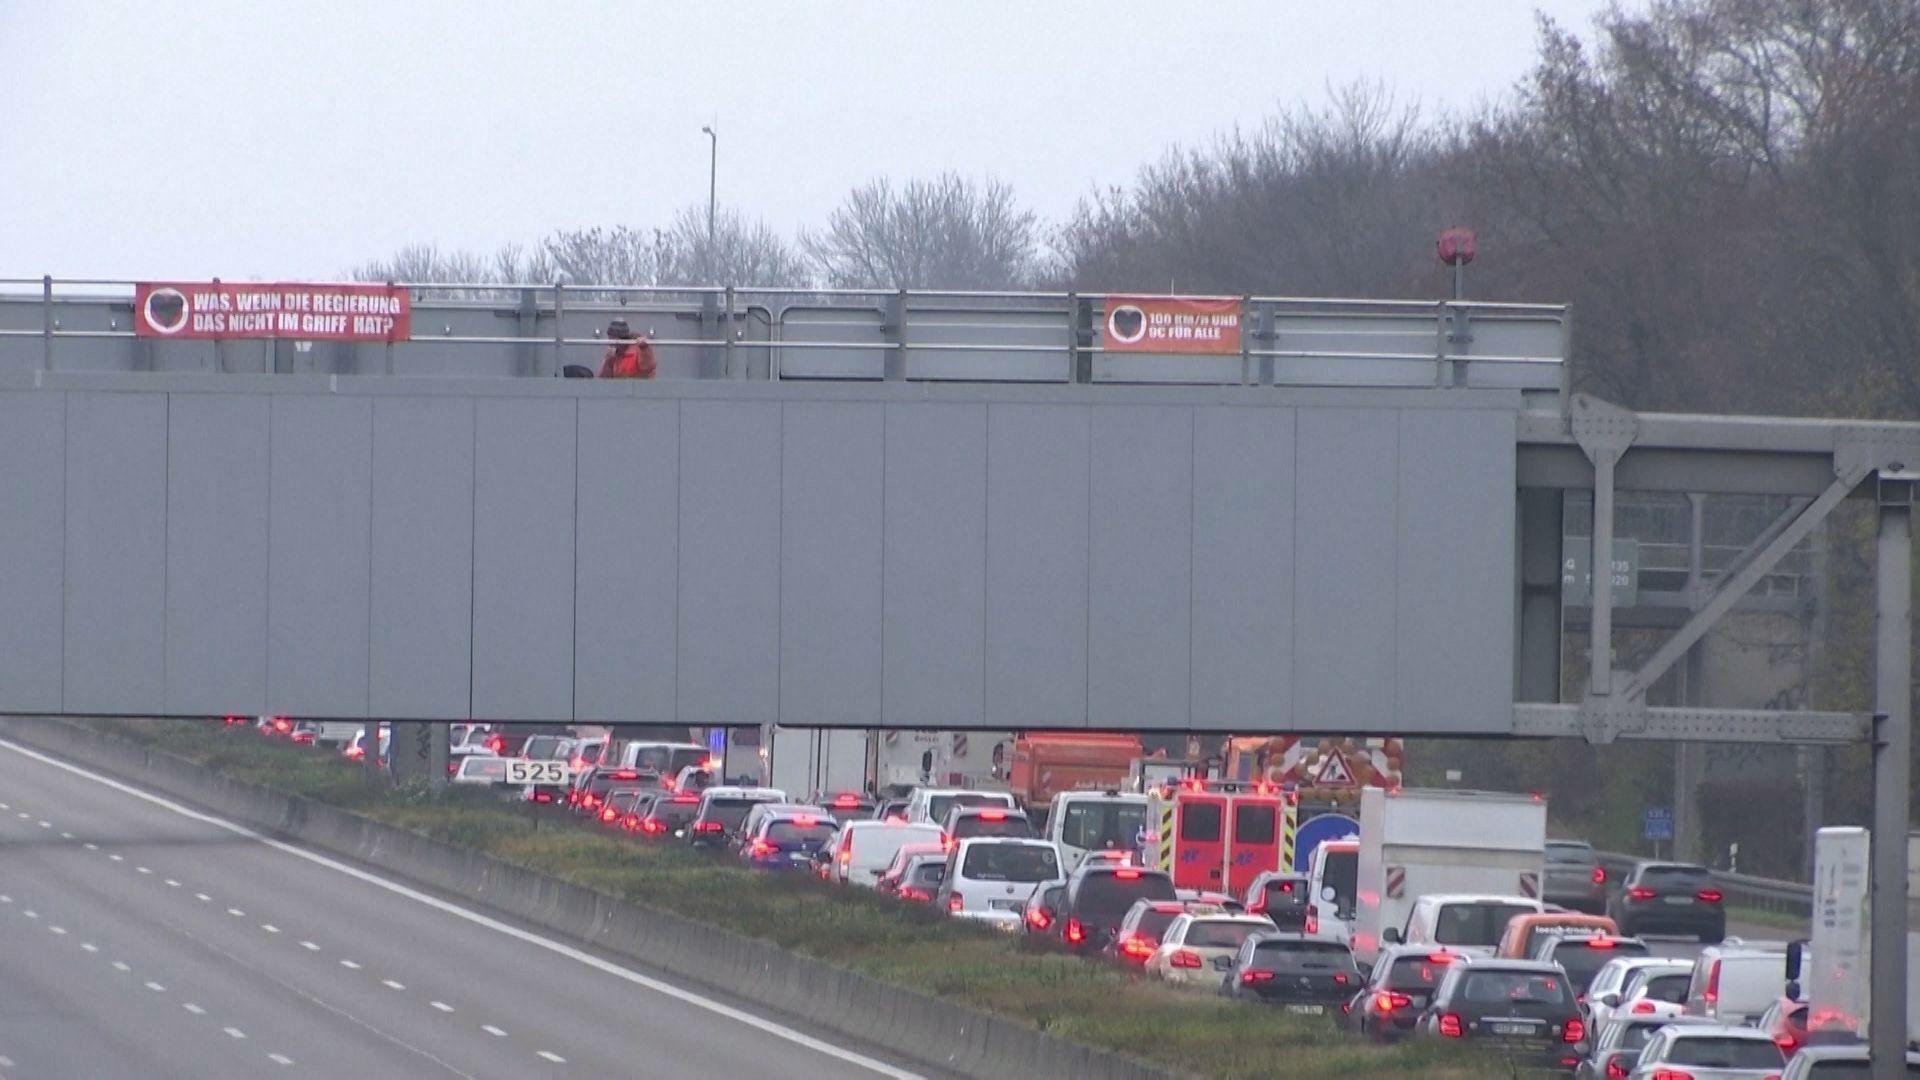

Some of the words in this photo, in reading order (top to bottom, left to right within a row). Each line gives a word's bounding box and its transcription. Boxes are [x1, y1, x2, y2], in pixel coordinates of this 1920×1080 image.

[193, 293, 233, 312] WAS,
[236, 293, 281, 312] WENN
[284, 293, 310, 311] DIE
[313, 294, 400, 314] REGIERUNG
[193, 313, 225, 332] DAS
[229, 313, 275, 332] NICHT
[278, 313, 299, 330] IM
[302, 314, 347, 332] GRIFF
[353, 315, 394, 334] HAT?
[1149, 313, 1171, 324] 100
[1211, 314, 1237, 326] UND
[1194, 327, 1221, 339] ALLE
[512, 762, 562, 781] 525
